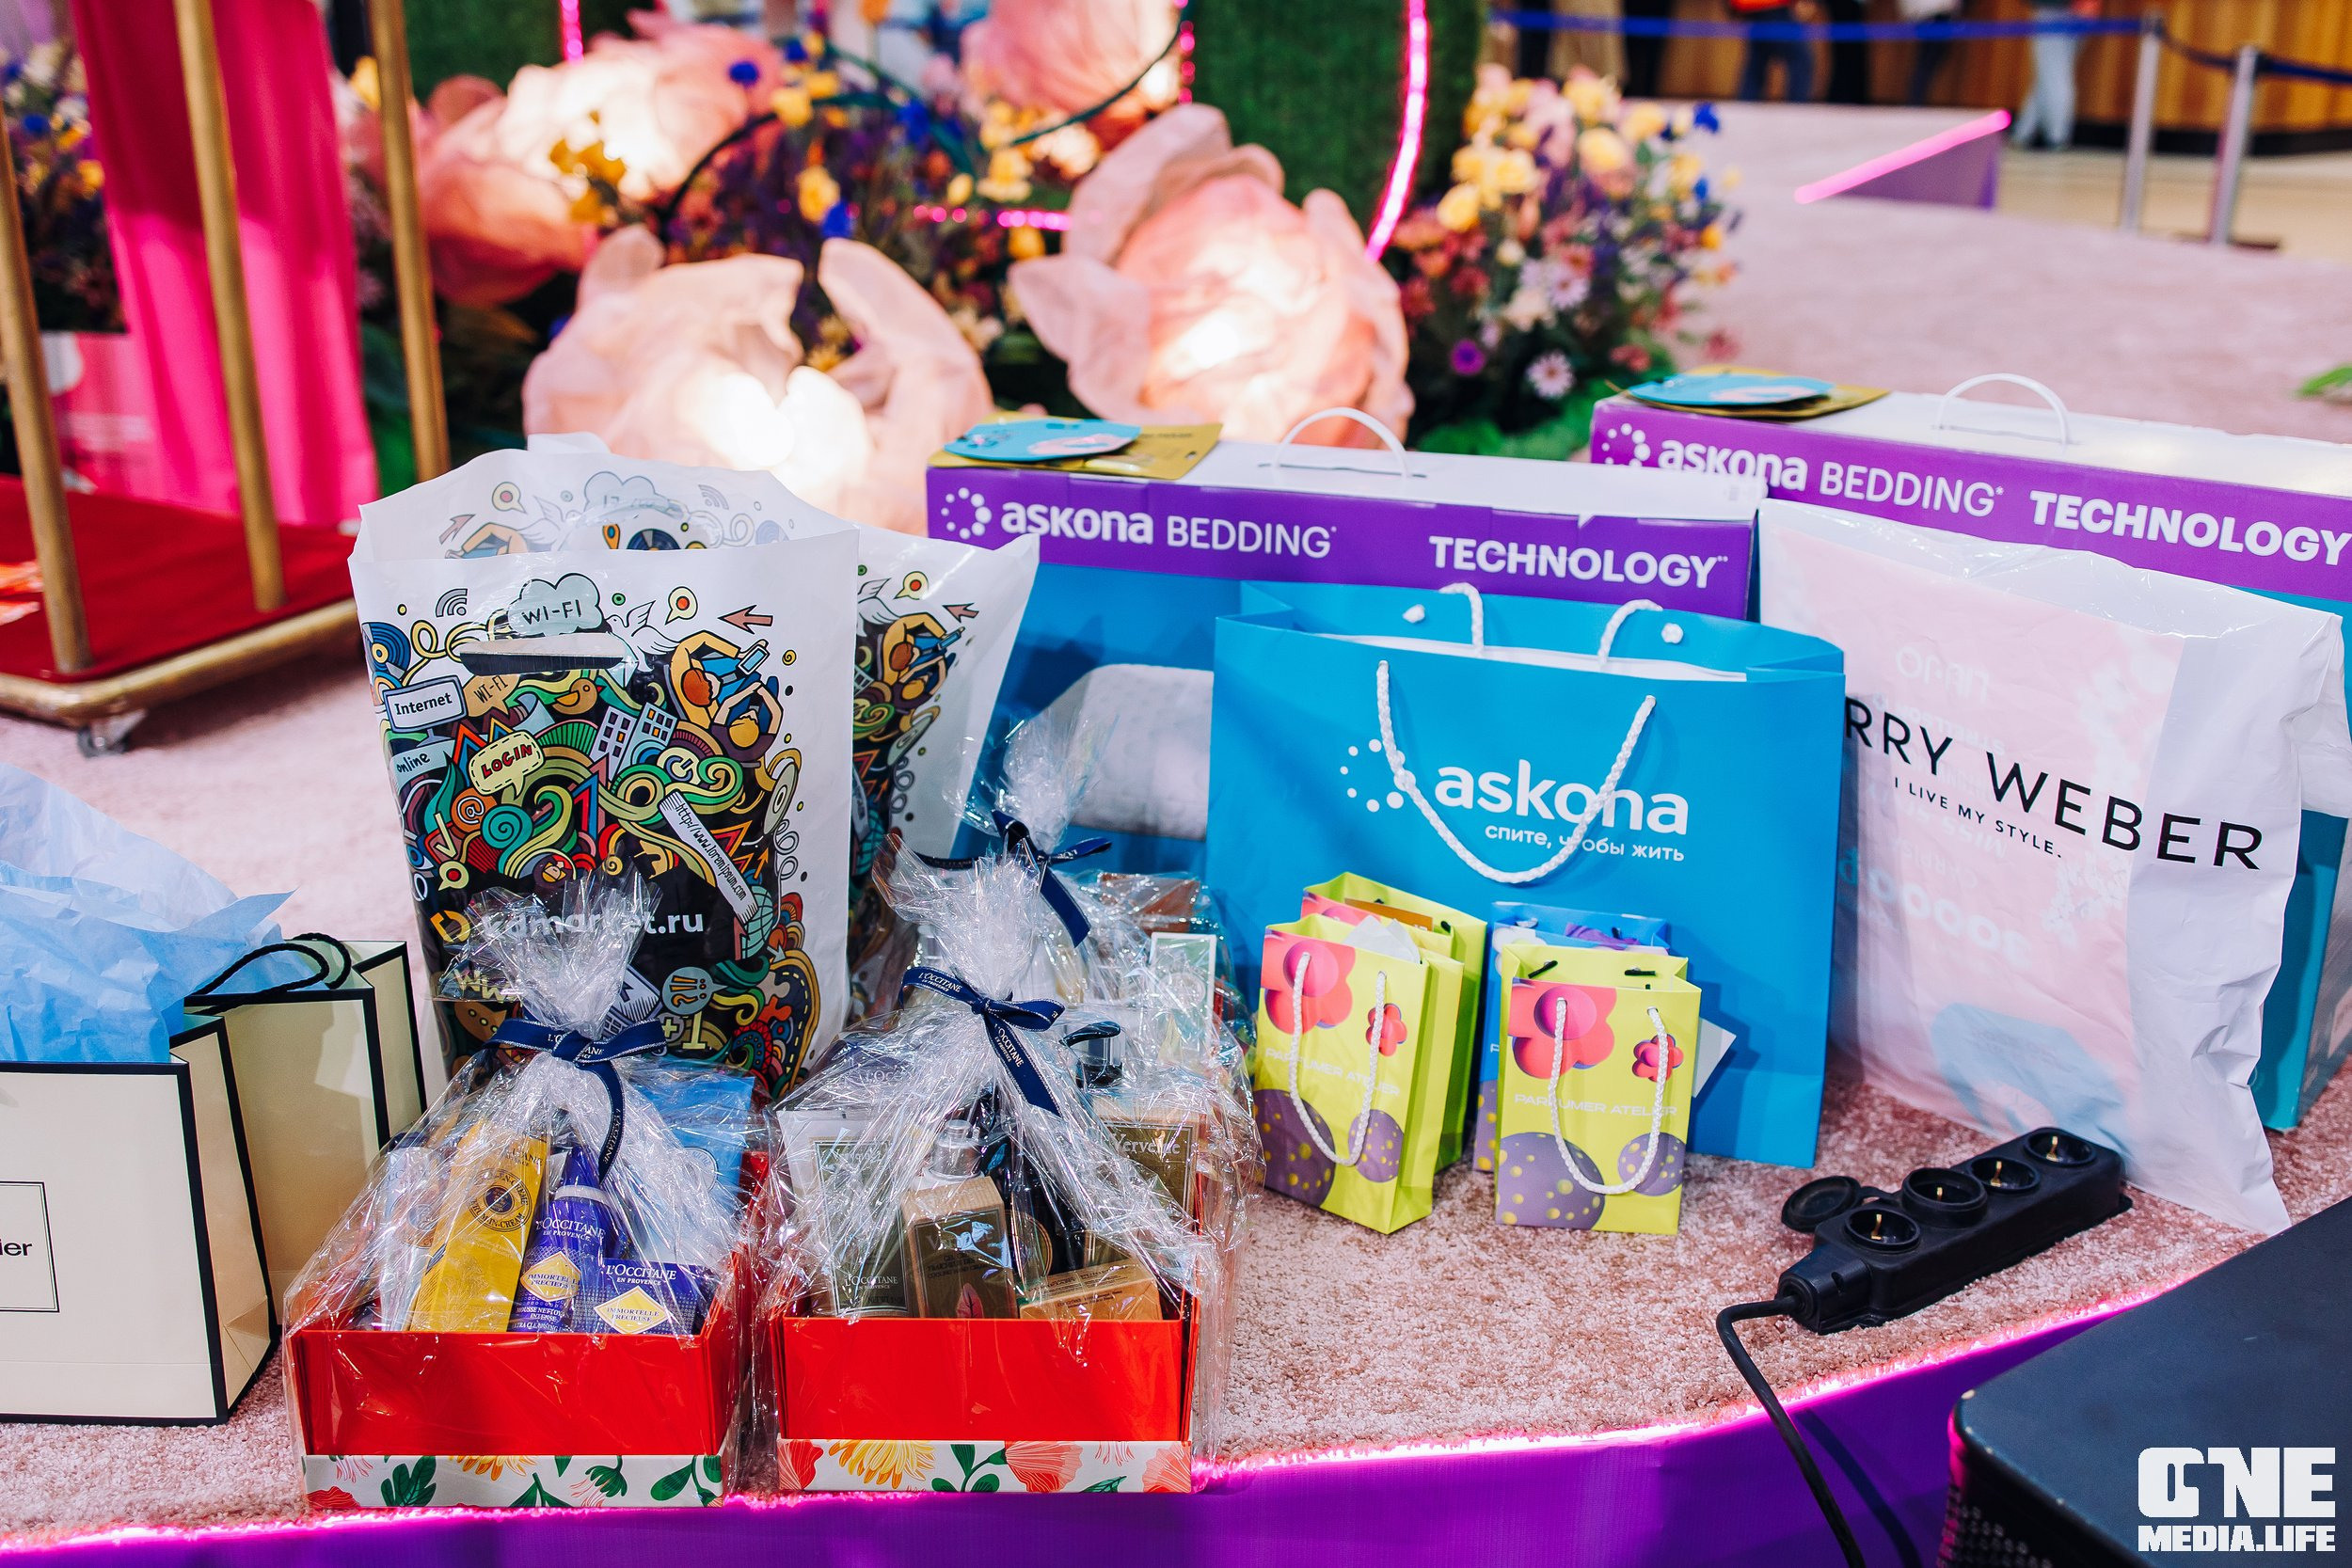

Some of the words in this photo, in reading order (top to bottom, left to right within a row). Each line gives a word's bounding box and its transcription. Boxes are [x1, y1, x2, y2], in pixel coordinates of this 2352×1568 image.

[1658, 439, 1808, 492] askona
[2030, 490, 2352, 566] TECHNOLOGY
[1000, 499, 1154, 545] askona
[1429, 535, 1718, 589] TECHNOLOGY
[521, 599, 582, 626] WI-FI
[394, 692, 453, 716] Internet
[473, 674, 508, 704] WI-FI
[396, 752, 431, 774] online
[480, 743, 533, 779] LOGIN
[1435, 758, 1690, 835] askona
[1845, 696, 1953, 776] RRY
[1987, 752, 2263, 871] WEBER
[1894, 776, 1899, 788] I
[1909, 783, 1948, 809] LIVE
[1958, 804, 1985, 824] MY
[1995, 820, 2062, 858] STYLE.
[675, 802, 747, 901] http://www.loremipsum.com
[1485, 824, 1551, 849] спите,
[1558, 835, 1625, 856] чобы
[1631, 843, 1684, 863] жить
[1514, 1094, 1606, 1114] PARUMER
[1611, 1104, 1678, 1117] ATELER
[606, 1264, 677, 1280] L'OCCITANE
